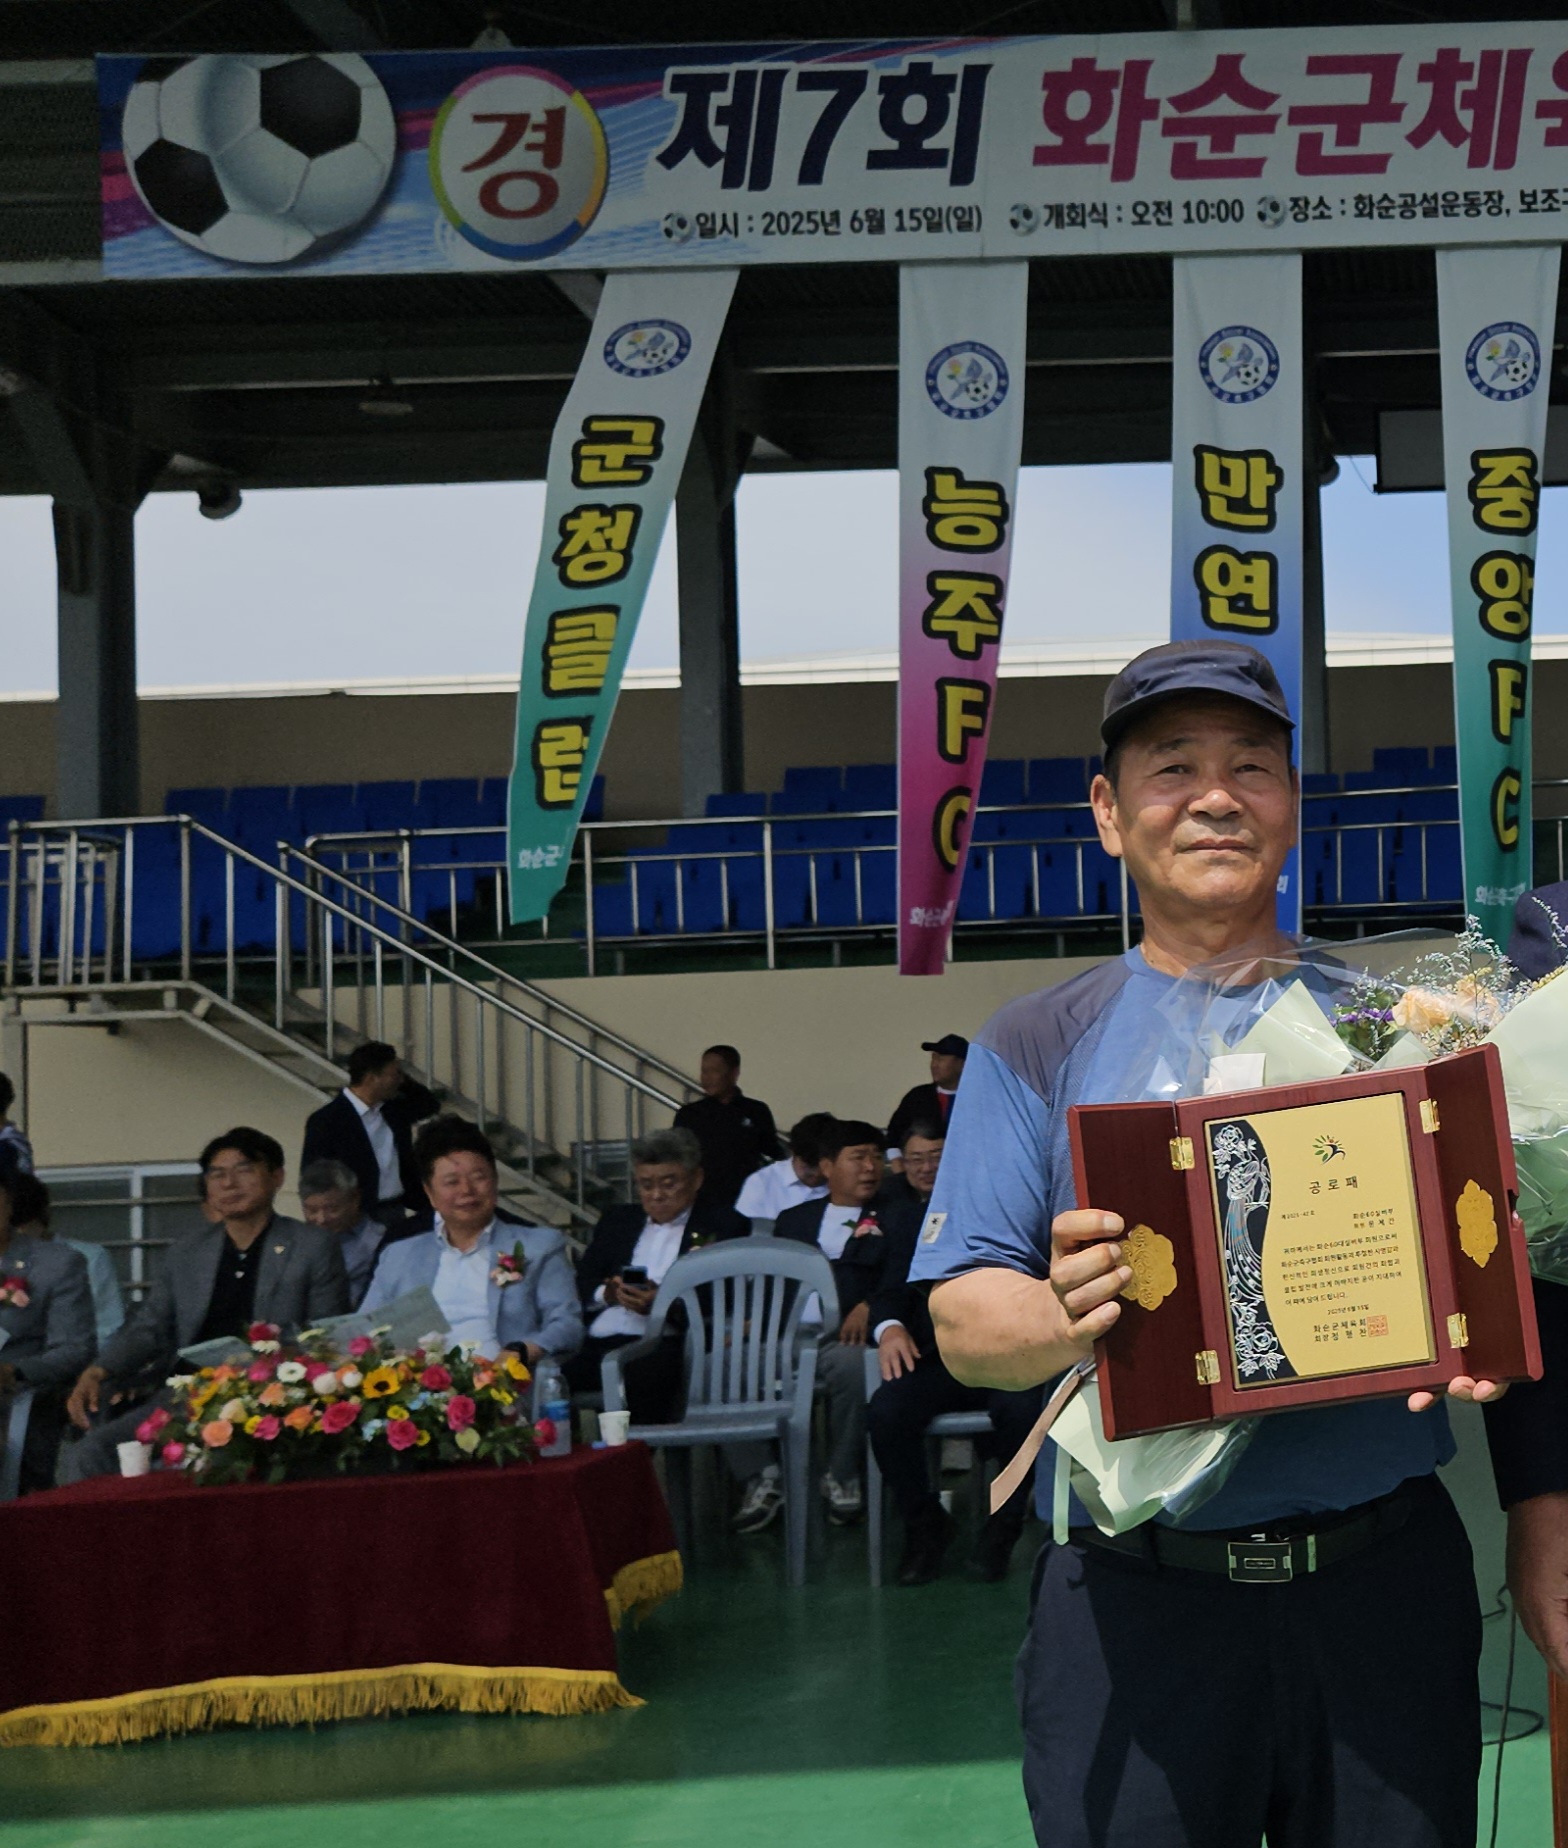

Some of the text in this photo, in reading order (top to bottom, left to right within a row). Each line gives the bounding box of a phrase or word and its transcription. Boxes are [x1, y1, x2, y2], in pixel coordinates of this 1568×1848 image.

[462, 107, 565, 220] 경
[656, 61, 994, 193] 제7회
[696, 212, 740, 239] 일시
[761, 209, 842, 238] 2025년
[849, 207, 886, 236] 6월
[894, 204, 983, 235] 15일(일)
[1044, 201, 1109, 230] 개회식
[1130, 201, 1173, 227] 오전
[1182, 199, 1245, 224] 10:00
[1289, 196, 1333, 222] 장소
[1353, 190, 1511, 221] 화순공설운동장,
[1193, 443, 1283, 635] 만연
[1468, 447, 1541, 852] 중앙FC
[517, 844, 564, 870] 화순군
